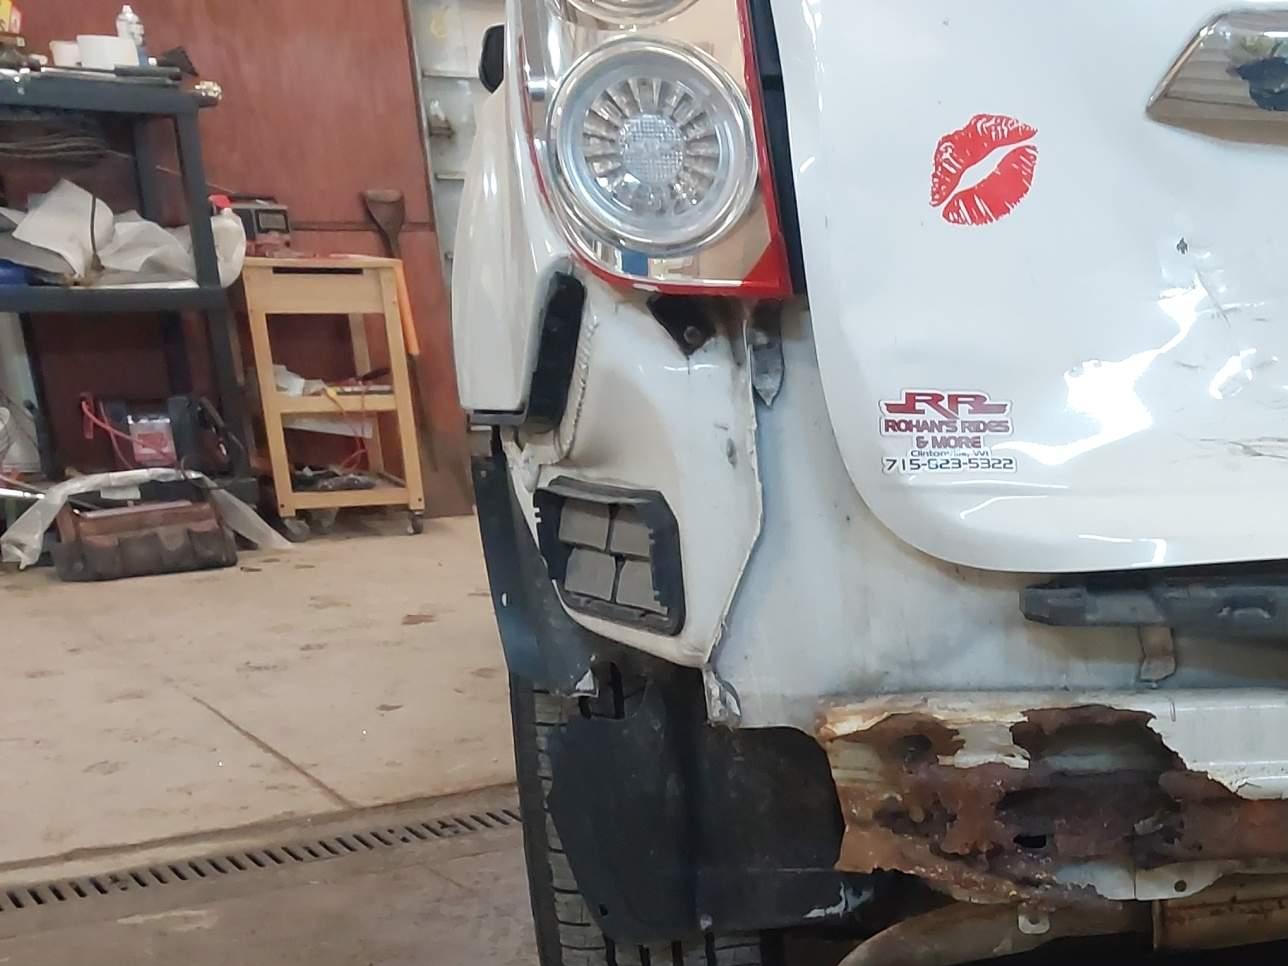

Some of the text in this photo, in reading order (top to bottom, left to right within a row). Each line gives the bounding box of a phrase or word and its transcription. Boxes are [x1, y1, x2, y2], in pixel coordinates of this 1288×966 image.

[884, 419, 1010, 433] ROHAN'S RIDES
[916, 436, 982, 449] & MORE
